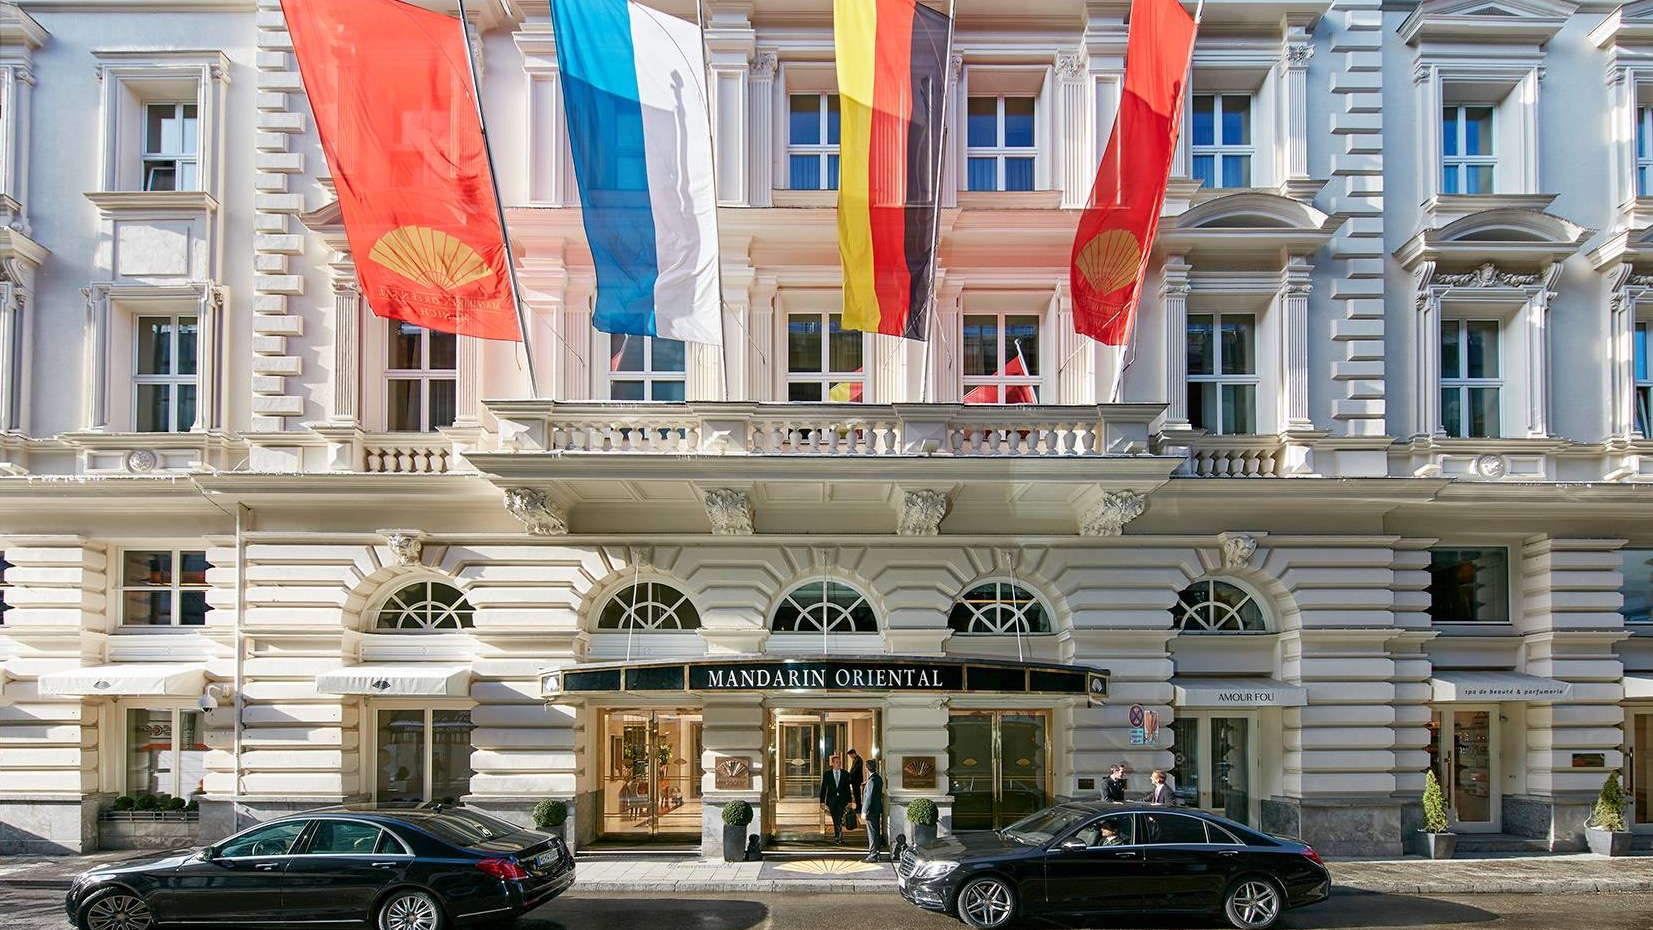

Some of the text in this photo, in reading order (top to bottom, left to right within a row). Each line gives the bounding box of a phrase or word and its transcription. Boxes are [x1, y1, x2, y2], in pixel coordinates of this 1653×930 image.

[708, 668, 943, 688] MANDARIN ORIENTAL
[1218, 693, 1275, 701] AMOUR FOU
